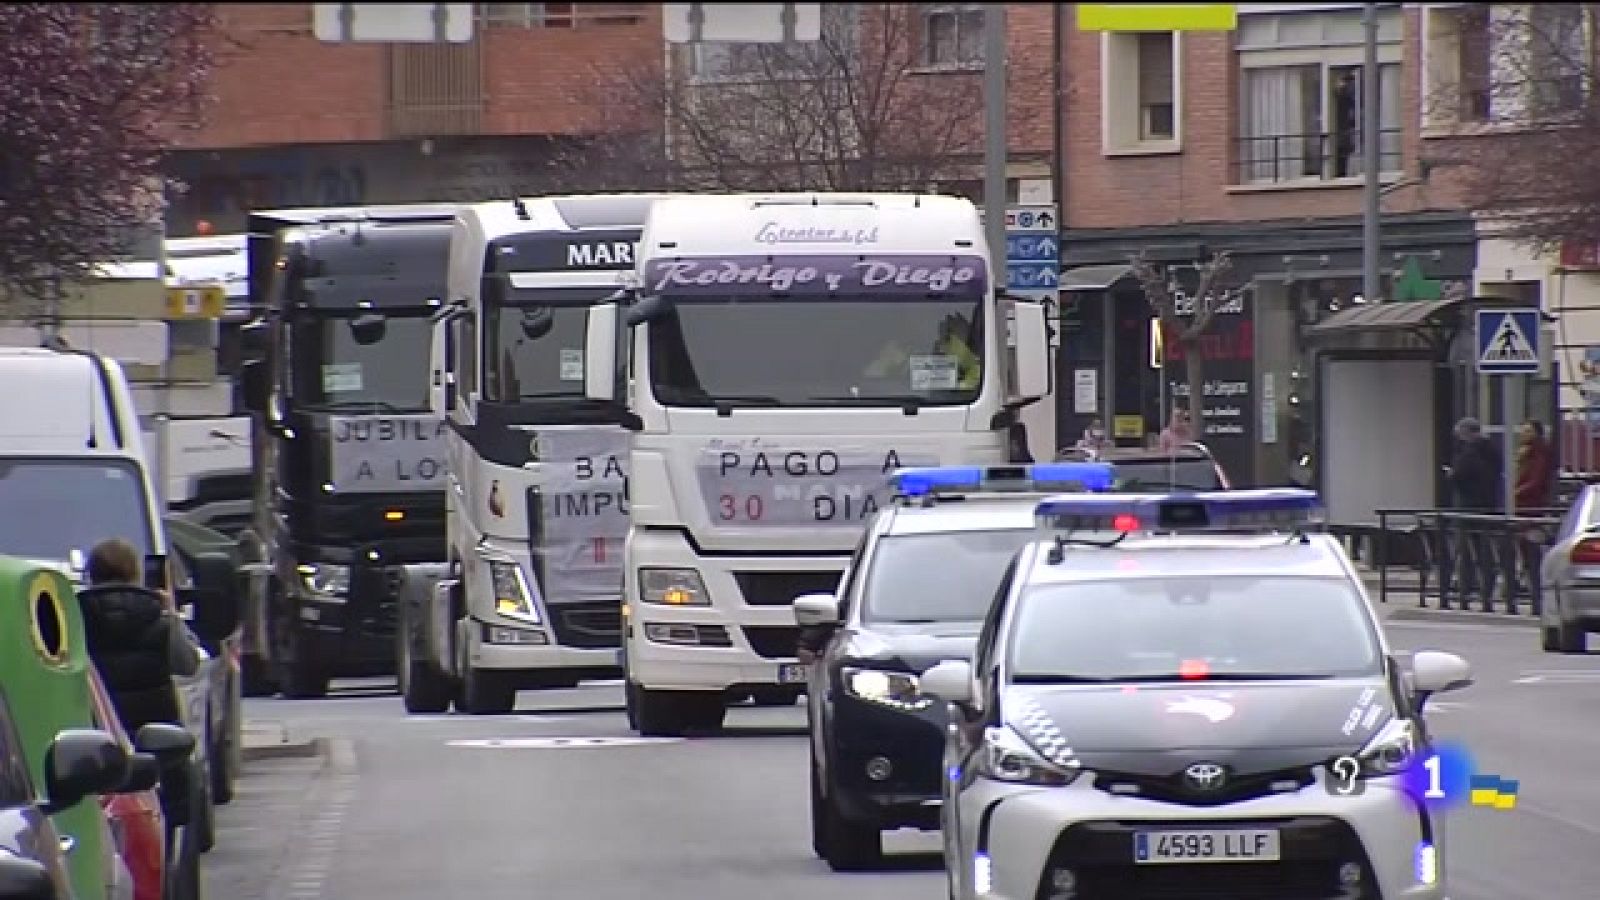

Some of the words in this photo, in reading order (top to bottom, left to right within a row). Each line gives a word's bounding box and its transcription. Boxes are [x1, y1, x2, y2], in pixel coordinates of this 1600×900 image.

[654, 260, 817, 291] Rodrigo
[824, 273, 843, 290] y
[851, 260, 976, 291] Diego
[357, 459, 374, 480] A
[719, 449, 839, 478] PAGO
[881, 449, 903, 474] A
[719, 494, 764, 521] 30
[814, 494, 907, 521] DIA
[1156, 834, 1214, 857] 4593
[1225, 834, 1269, 856] LLF
